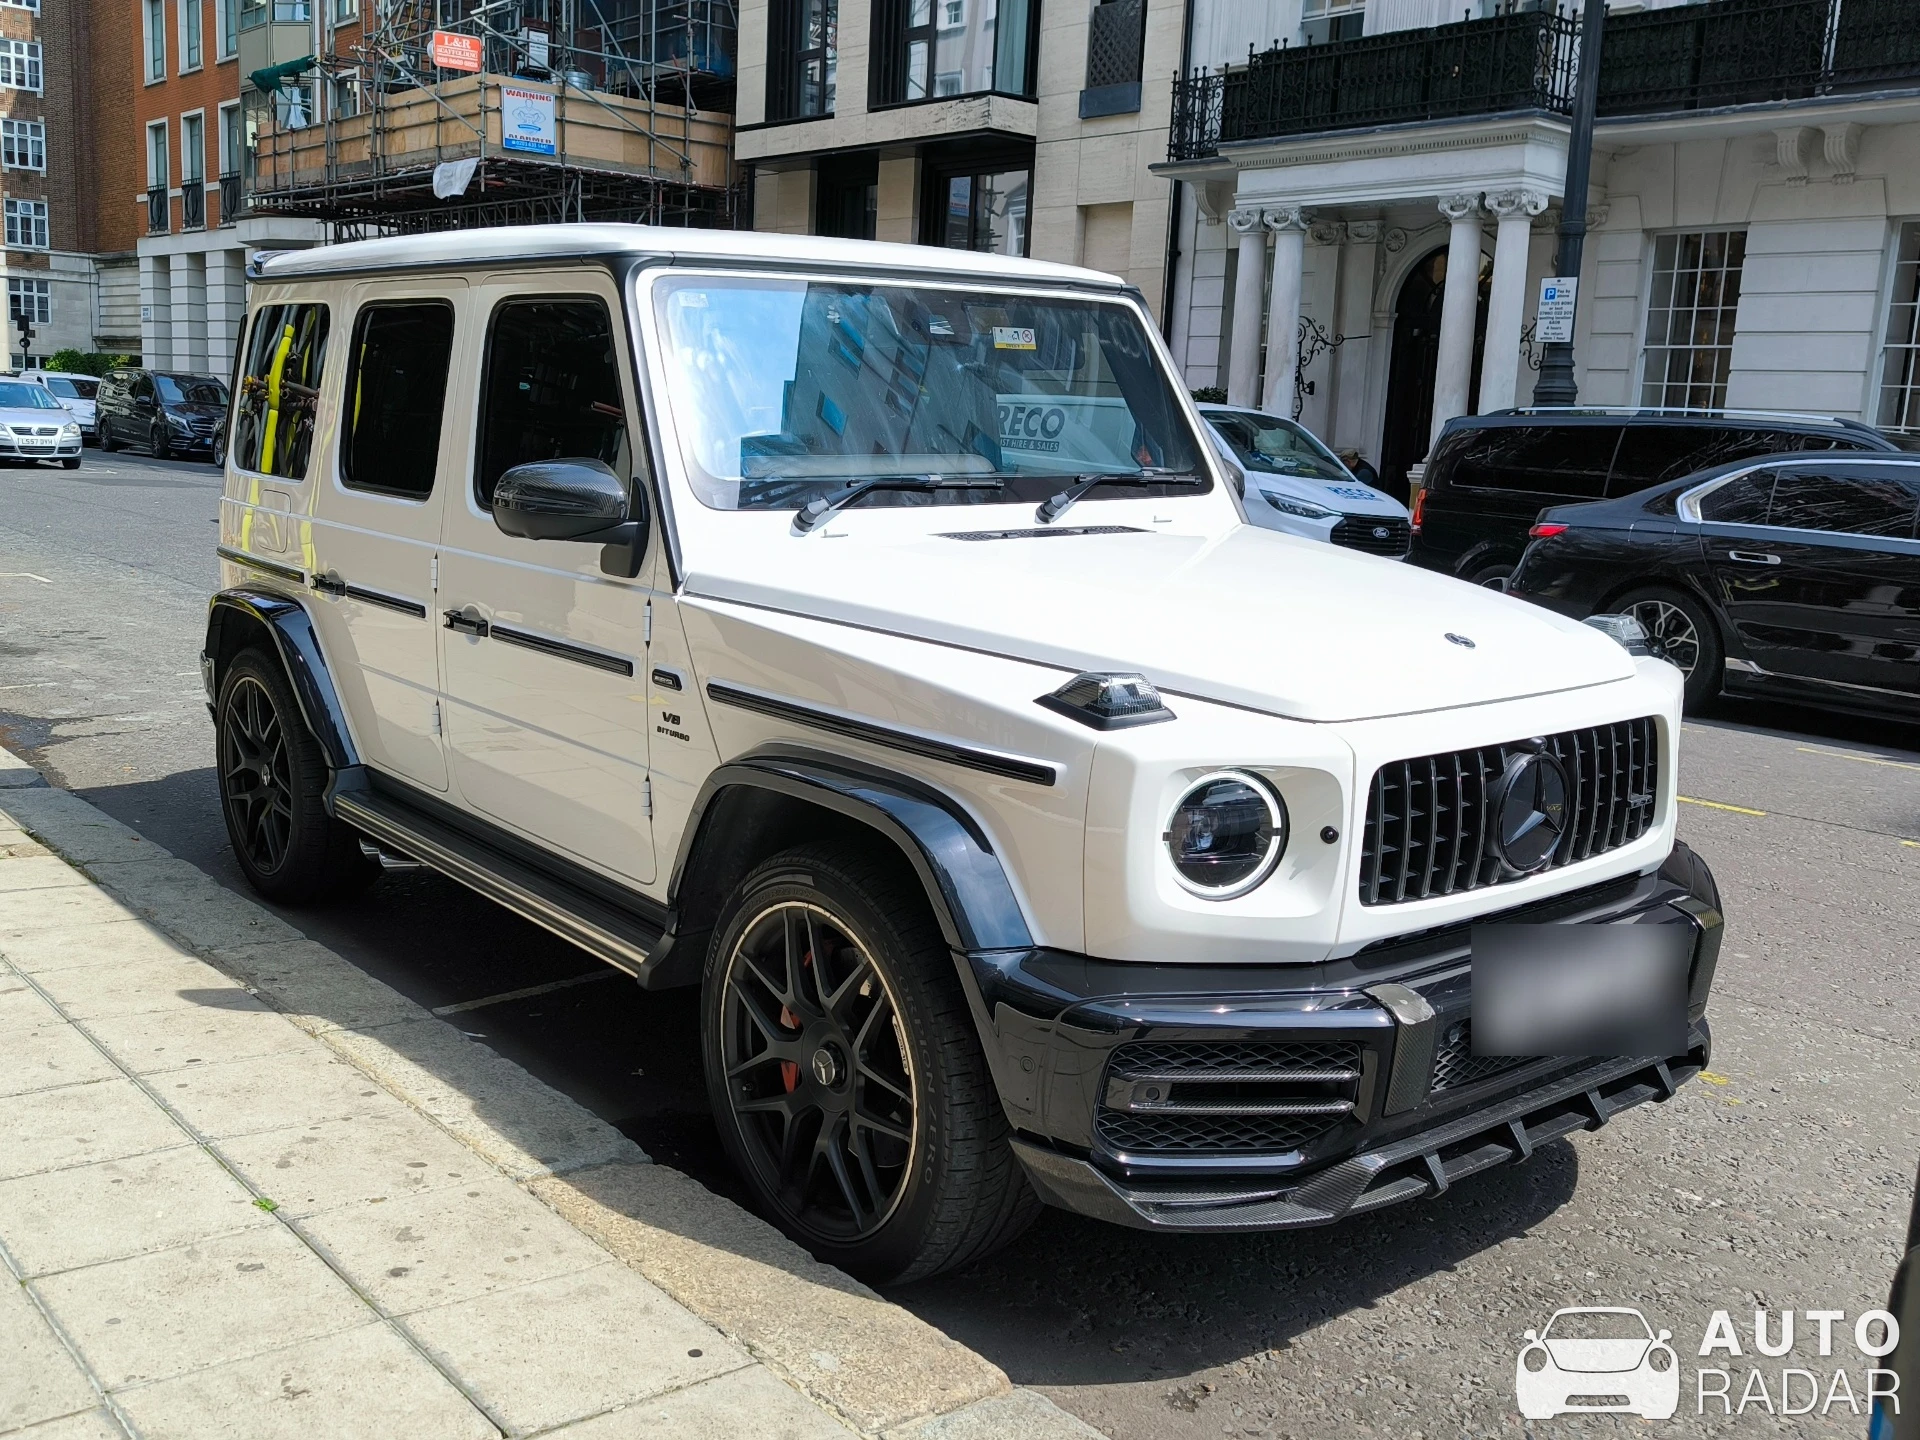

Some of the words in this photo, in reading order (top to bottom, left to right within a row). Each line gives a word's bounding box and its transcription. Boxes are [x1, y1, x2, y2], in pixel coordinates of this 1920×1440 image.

[444, 35, 470, 49] L&R
[437, 47, 478, 58] SCAFFOLDING
[505, 89, 552, 102] WARNING
[508, 133, 552, 144] ALARMED
[1011, 440, 1027, 449] HIRE
[1029, 441, 1035, 450] &
[1037, 441, 1059, 452] SALES
[662, 711, 681, 726] V8
[657, 725, 690, 742] BITURBO
[883, 941, 936, 1093] SCORPION
[924, 1103, 937, 1184] ZERO
